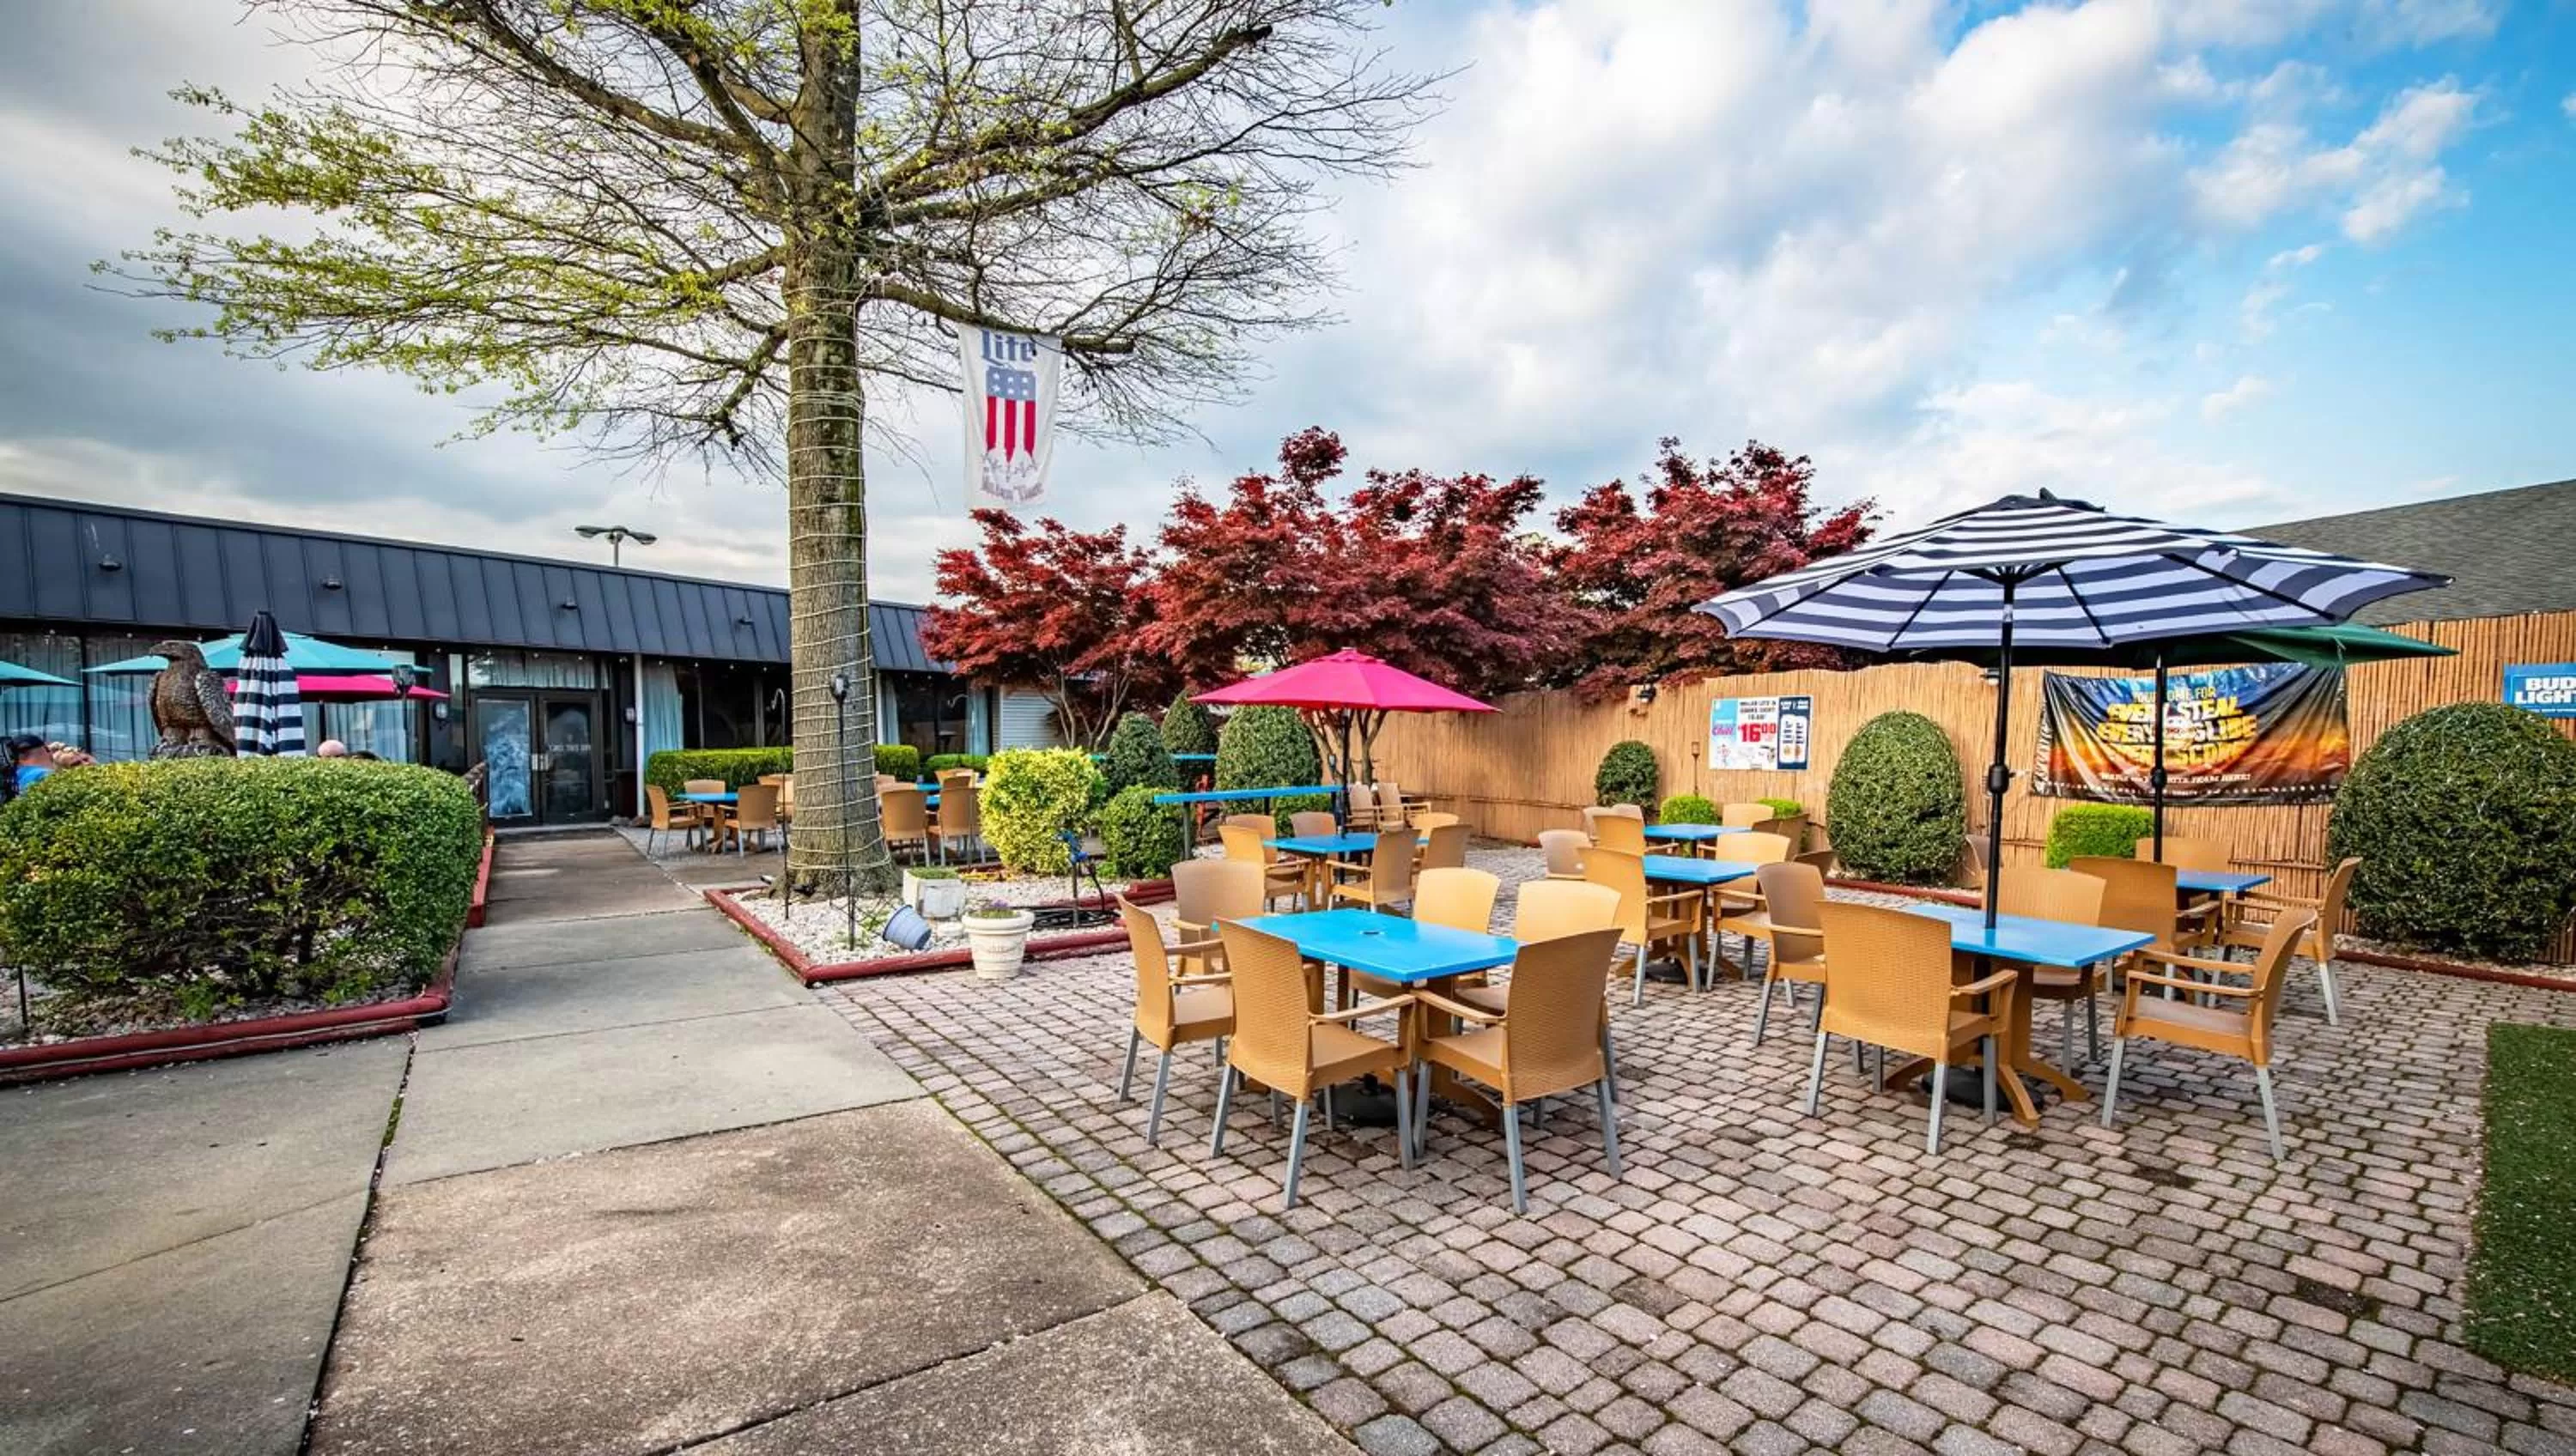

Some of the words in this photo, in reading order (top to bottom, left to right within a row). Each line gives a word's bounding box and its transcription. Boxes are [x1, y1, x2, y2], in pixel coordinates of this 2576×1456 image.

[2525, 676, 2576, 691] BUD
[2166, 688, 2191, 701] OME
[2195, 686, 2216, 700] FOR
